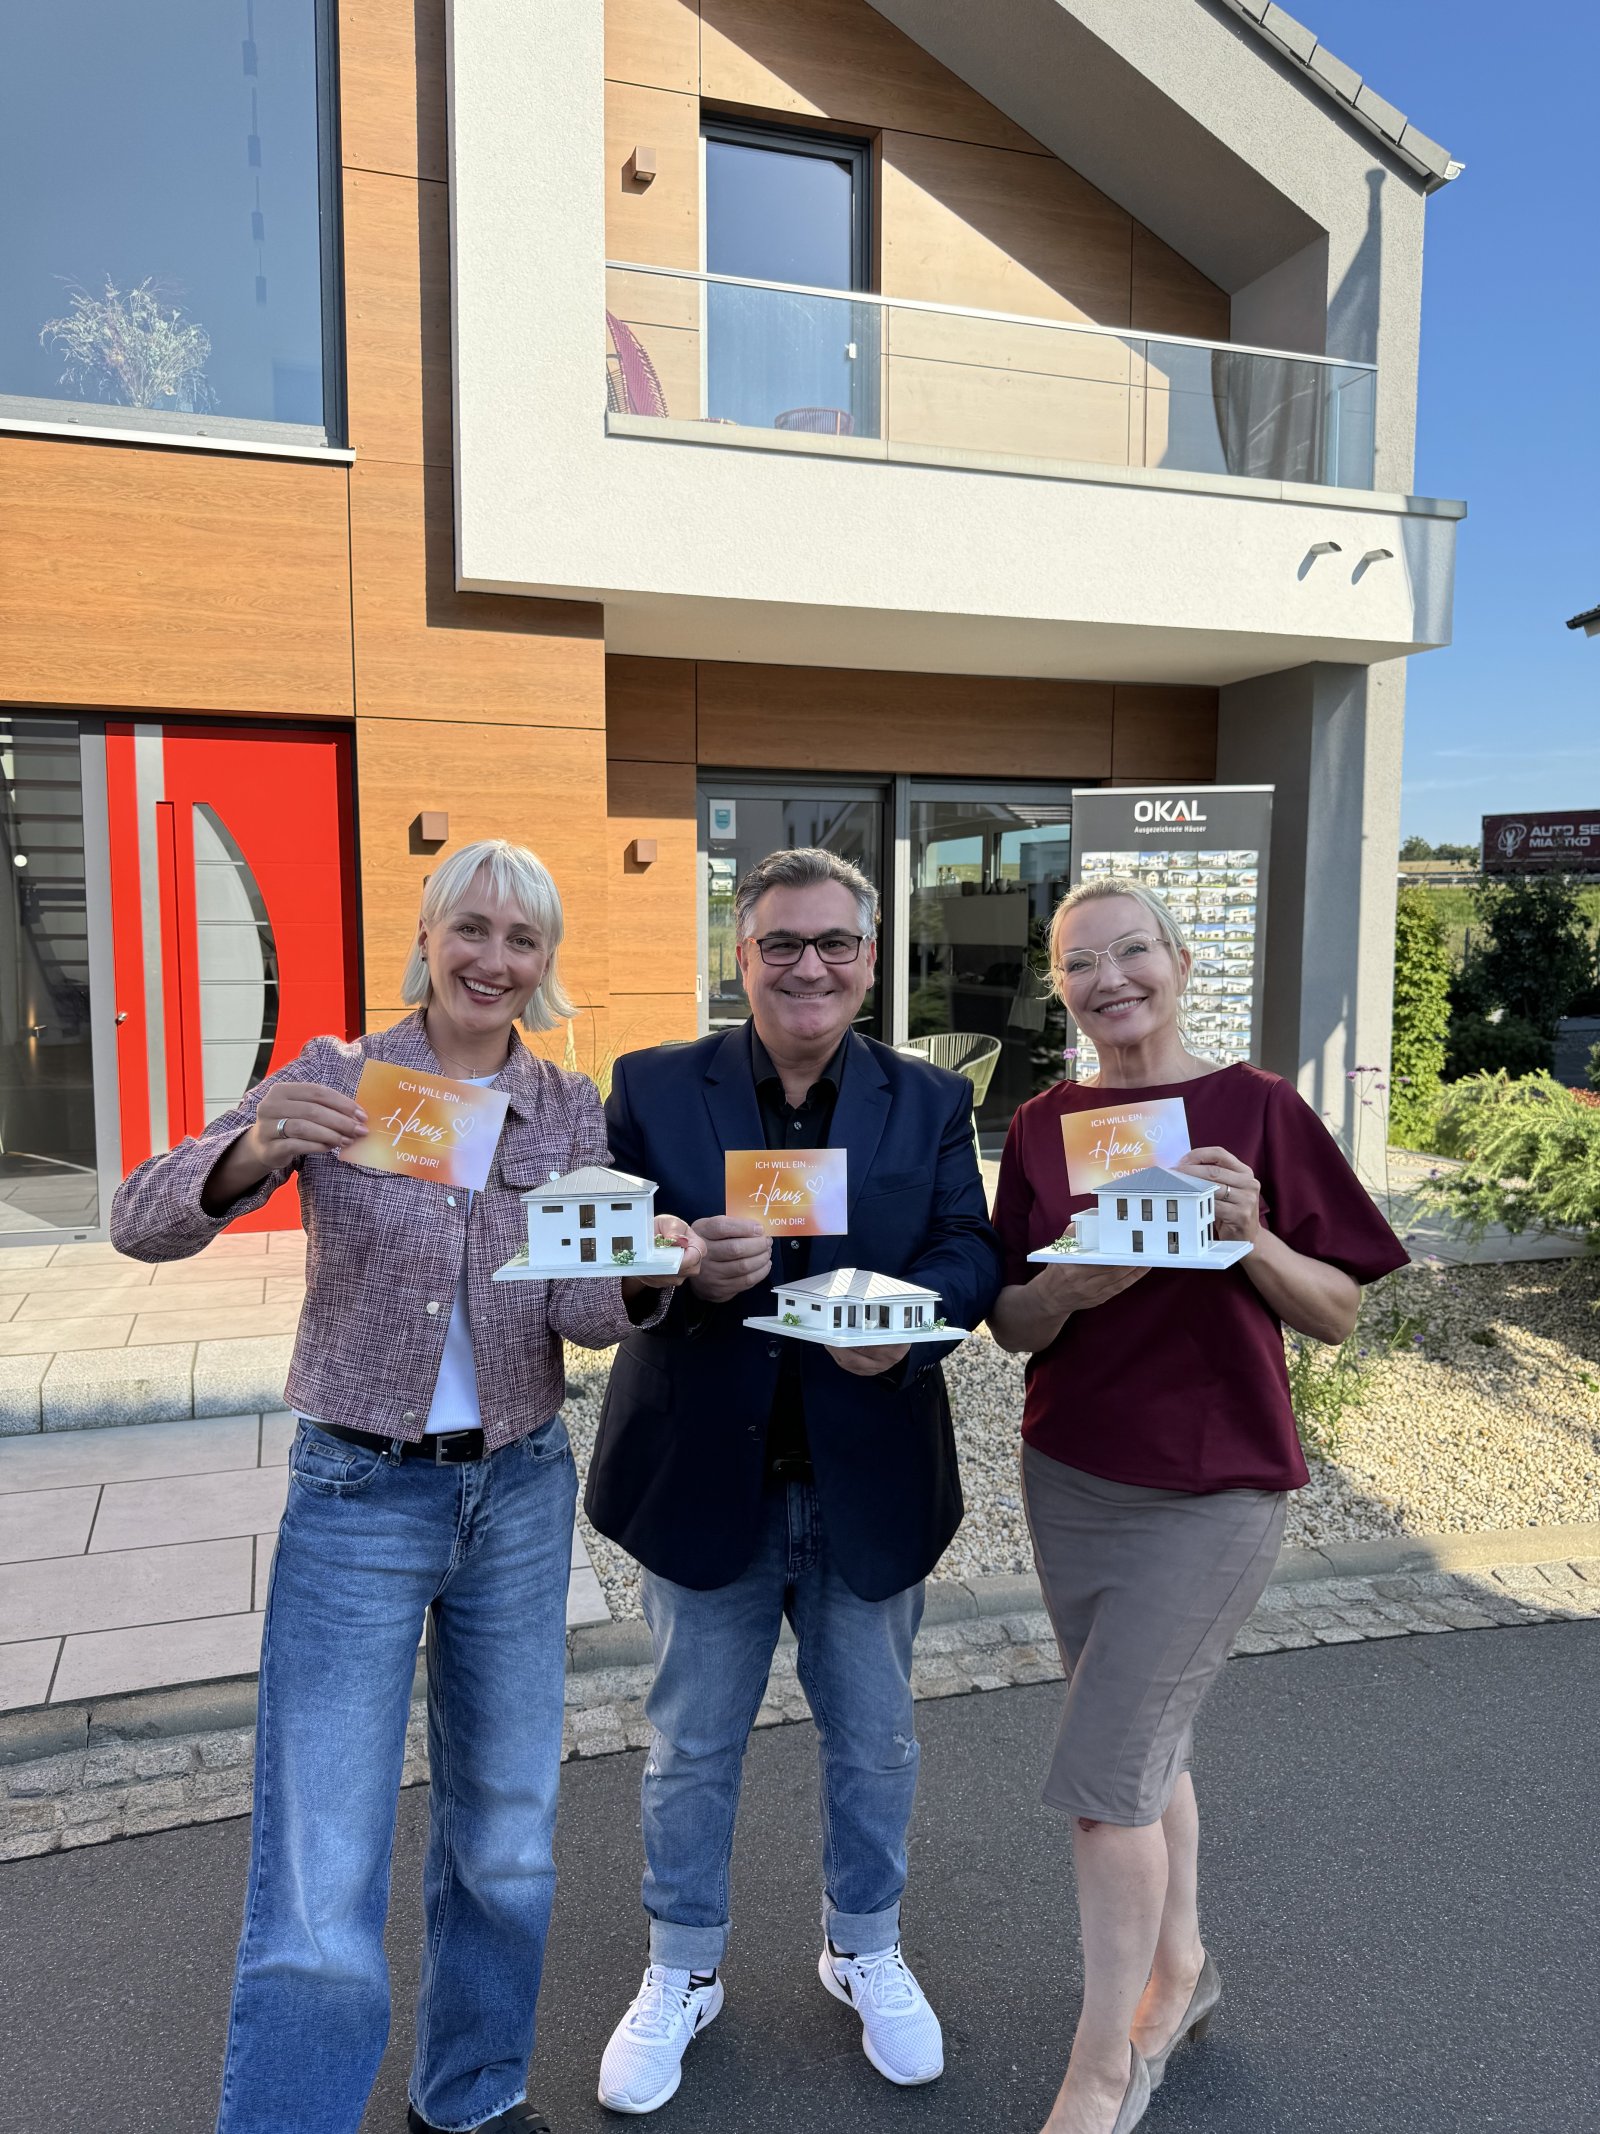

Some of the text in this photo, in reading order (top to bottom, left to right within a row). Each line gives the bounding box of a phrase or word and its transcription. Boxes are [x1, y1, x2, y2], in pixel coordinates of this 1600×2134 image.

[1134, 800, 1207, 822] OKAL
[1134, 825, 1207, 834] Ausgezeichnete Häuser
[1530, 825, 1574, 837] AUTO
[1529, 837, 1591, 848] MIATKO
[398, 1080, 416, 1093] ICH
[418, 1086, 441, 1099] WILL
[381, 1099, 448, 1147] Haus
[1091, 1119, 1106, 1128] ICH
[1107, 1115, 1128, 1125] WILL
[1088, 1126, 1145, 1171] Haus
[396, 1151, 440, 1169] VON DIR!
[755, 1161, 770, 1169] ICH
[771, 1161, 791, 1169] WILL
[1111, 1170, 1130, 1179] VON
[748, 1171, 804, 1216] Haus
[769, 1217, 806, 1226] VON DIR!
